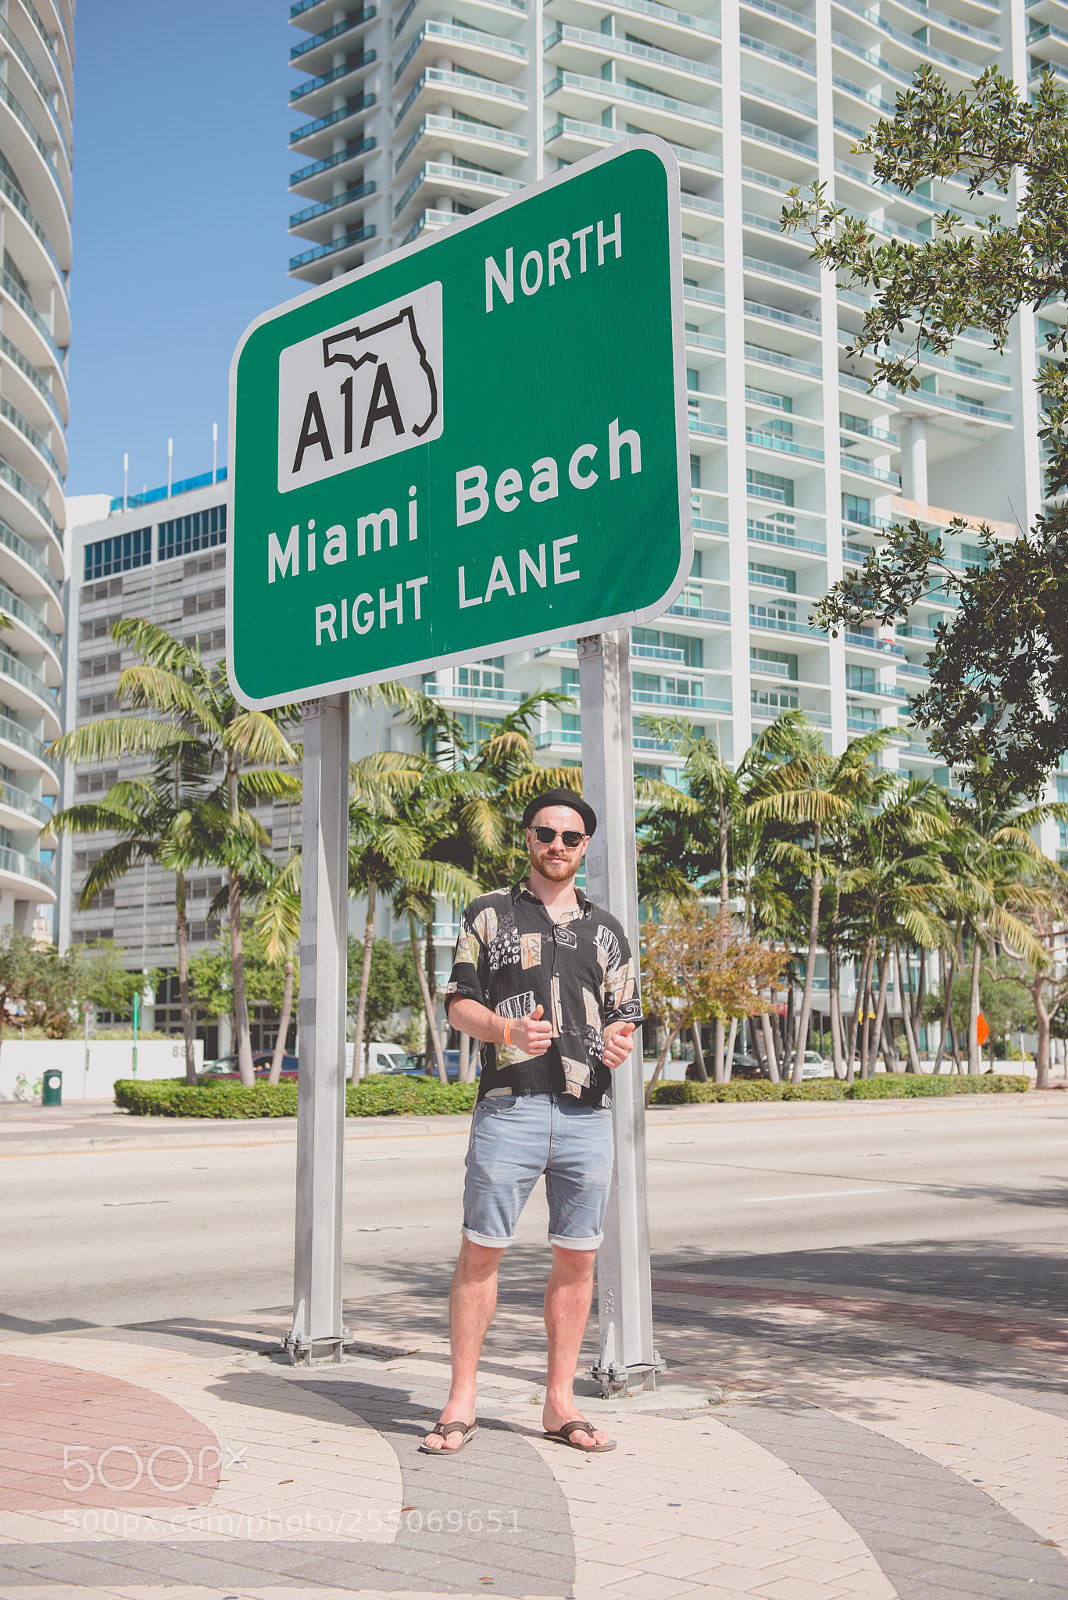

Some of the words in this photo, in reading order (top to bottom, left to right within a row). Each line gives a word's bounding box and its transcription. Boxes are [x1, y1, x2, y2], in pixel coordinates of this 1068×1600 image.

[291, 362, 405, 473] A1A
[267, 484, 419, 584] Miami
[456, 417, 642, 527] Beach
[314, 575, 429, 646] RIGHT
[458, 533, 581, 609] LANE
